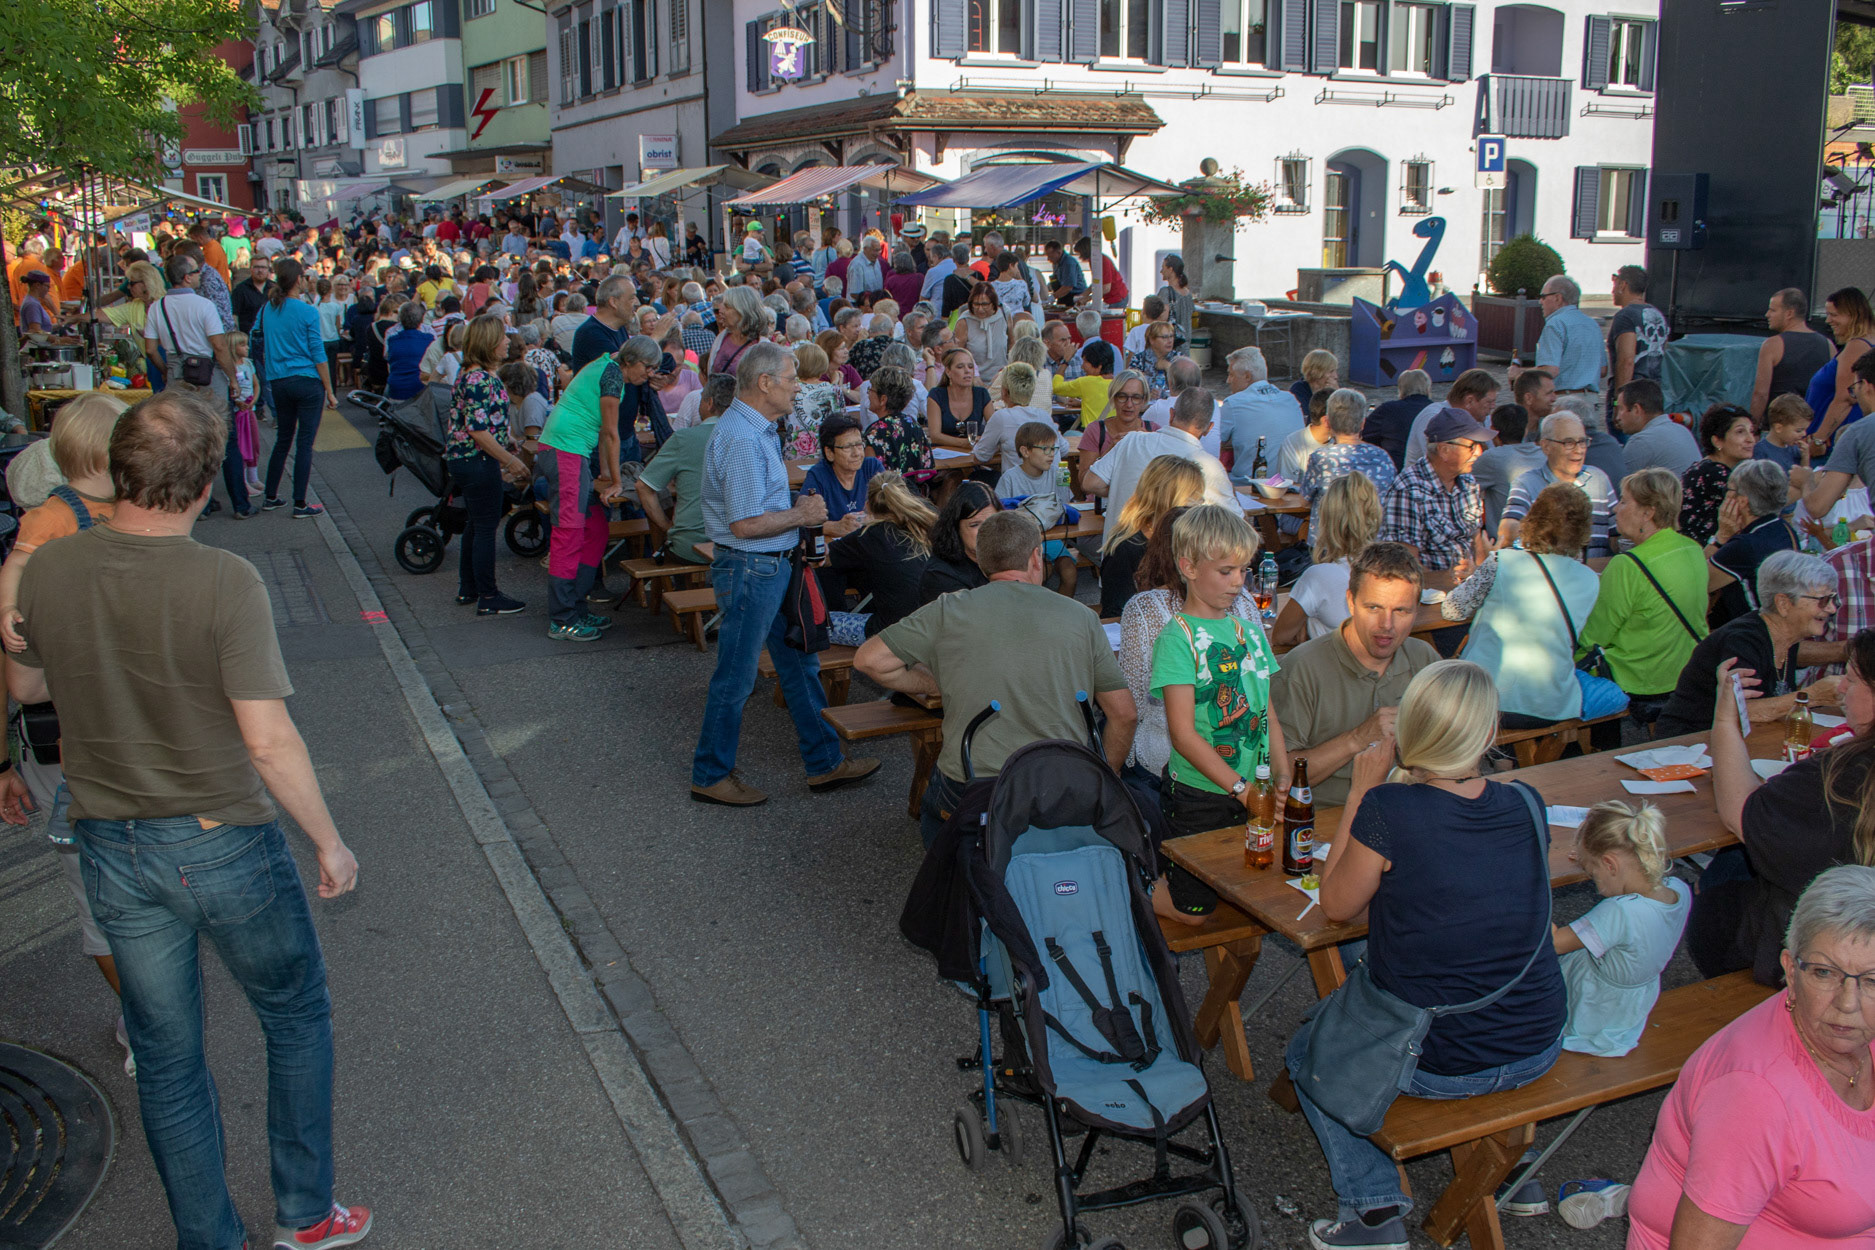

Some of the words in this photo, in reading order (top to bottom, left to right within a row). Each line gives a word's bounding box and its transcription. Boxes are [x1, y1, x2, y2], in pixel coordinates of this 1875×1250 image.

[768, 30, 810, 42] CONFISEUR
[354, 102, 362, 131] FRANK
[647, 149, 672, 158] obrist
[1485, 143, 1499, 168] P
[1057, 884, 1075, 892] chicco
